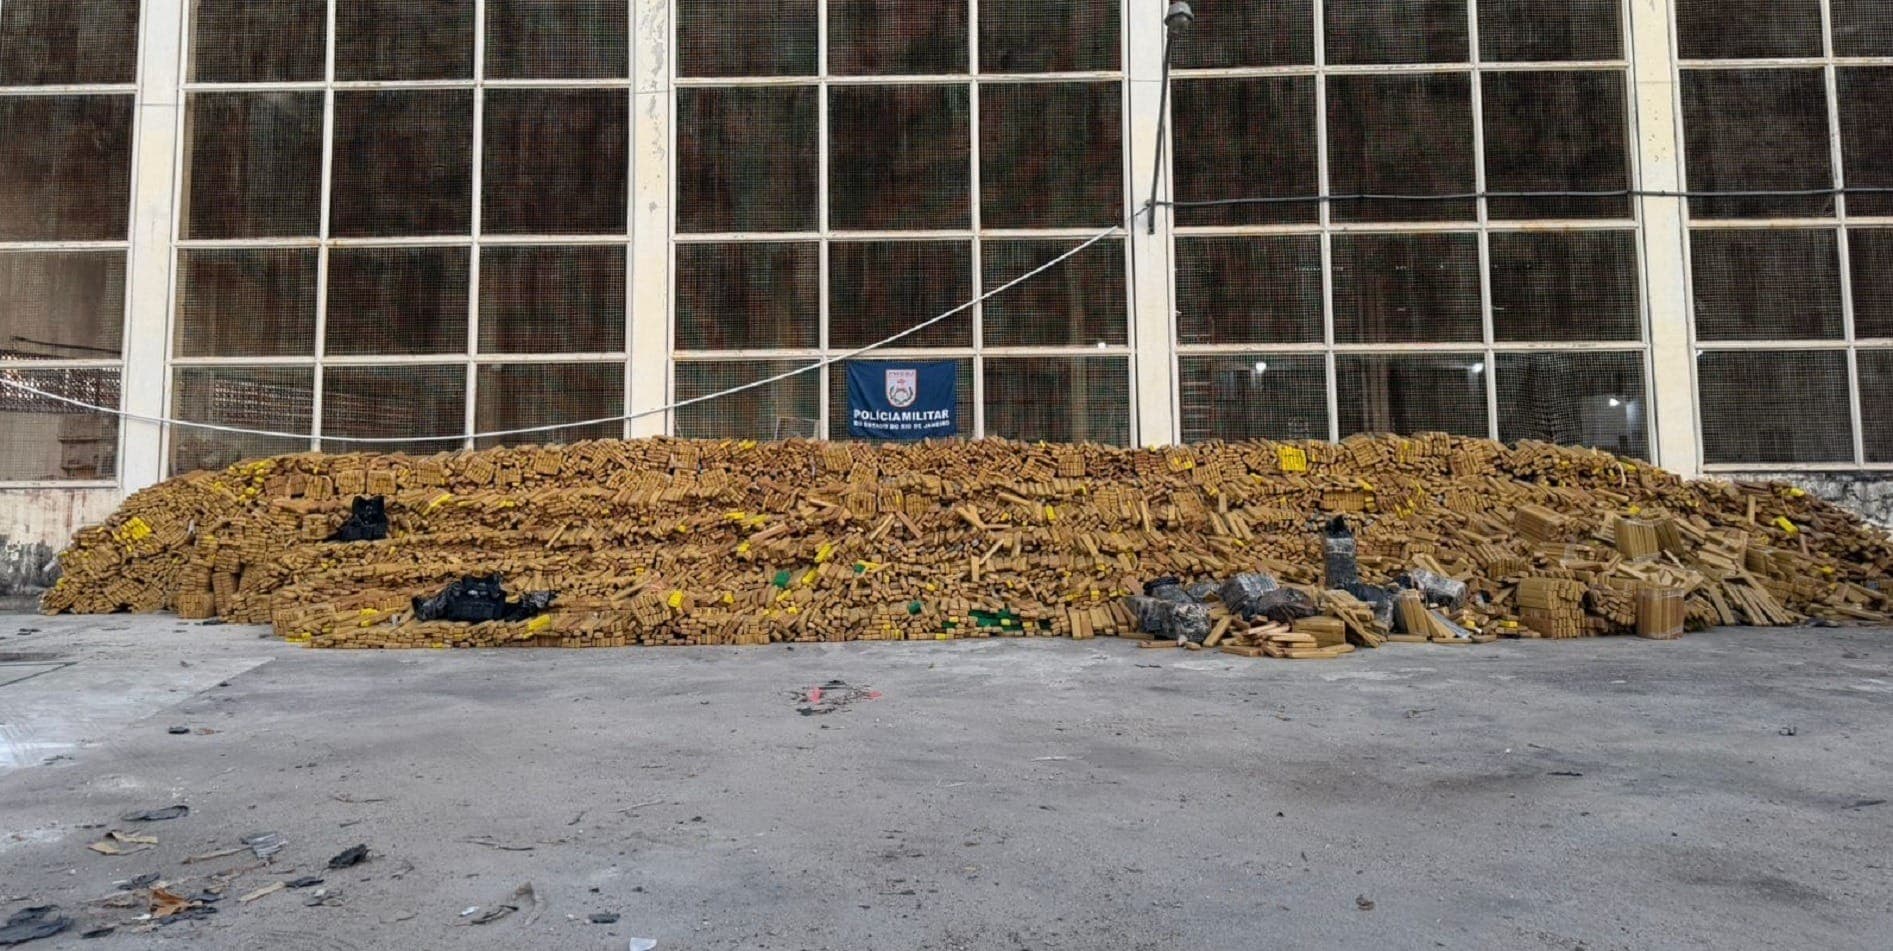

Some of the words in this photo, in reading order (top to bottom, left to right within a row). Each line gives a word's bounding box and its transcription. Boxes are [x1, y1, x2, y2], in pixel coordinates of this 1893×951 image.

[853, 409, 901, 421] POLÍCIA
[901, 409, 949, 421] MILITAR
[864, 421, 889, 430] ESTADO
[923, 420, 950, 429] JANEIRO
